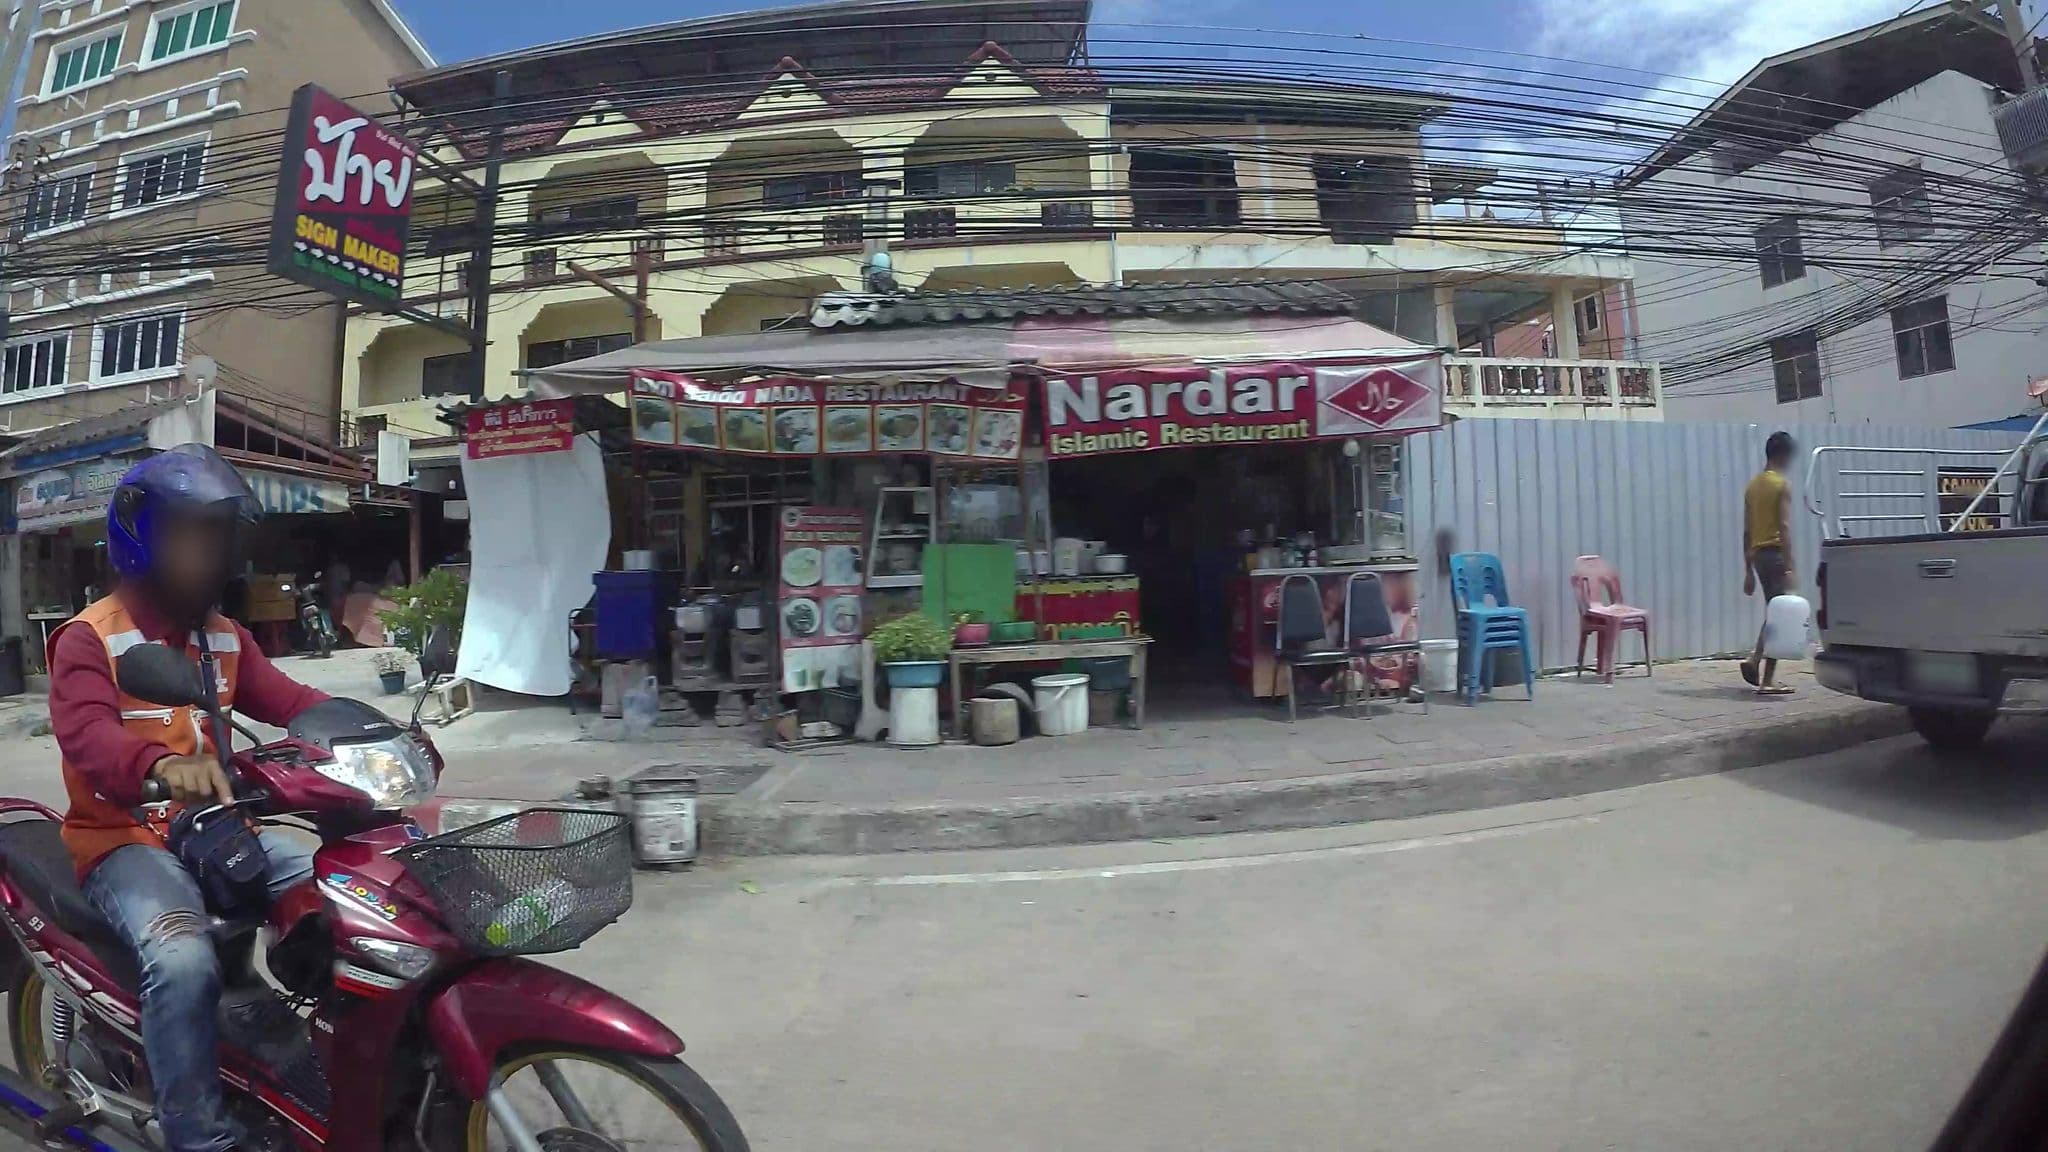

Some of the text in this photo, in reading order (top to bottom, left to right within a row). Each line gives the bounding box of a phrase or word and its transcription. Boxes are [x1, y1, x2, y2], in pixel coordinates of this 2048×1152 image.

[304, 116, 412, 208] ป้าย
[296, 214, 400, 275] SIGN MAKER
[1047, 368, 1309, 427] Nardar
[1356, 381, 1405, 413] حلال
[1051, 418, 1310, 454] Islamic Restaurant
